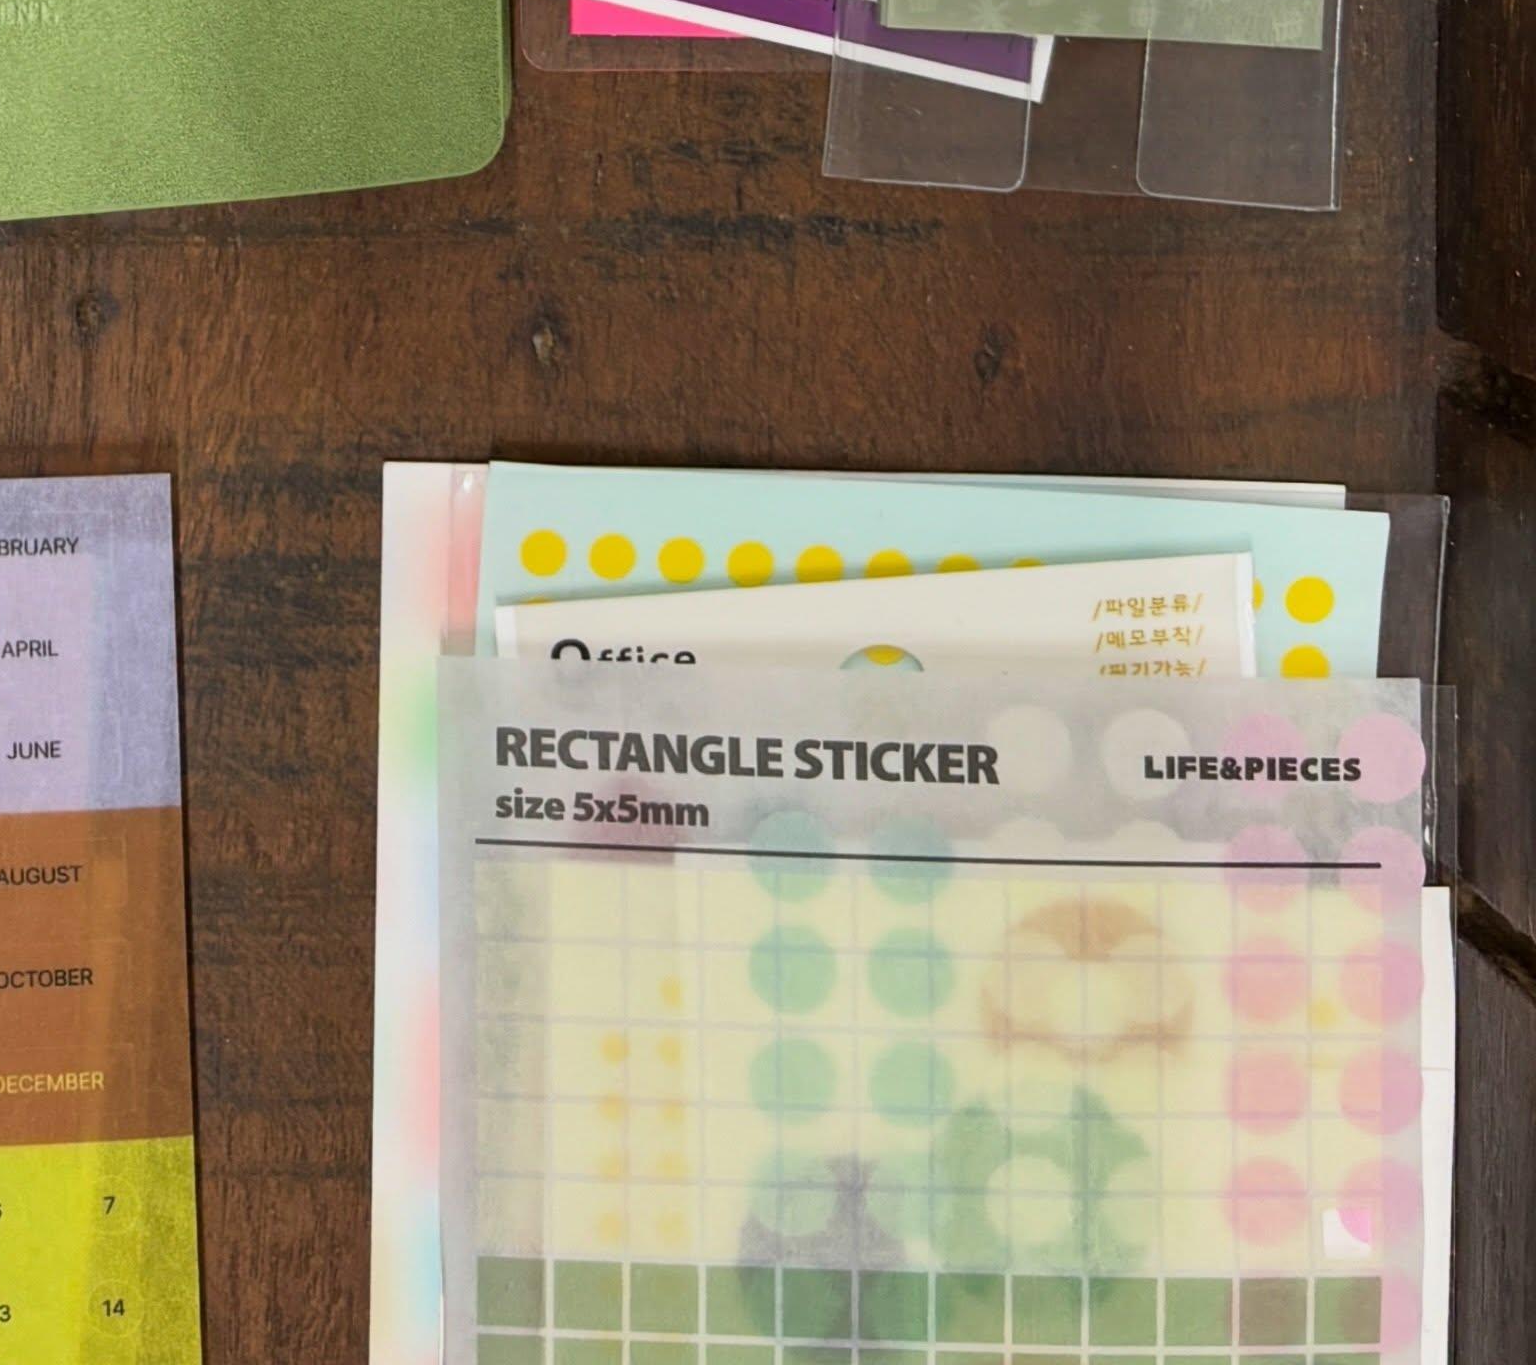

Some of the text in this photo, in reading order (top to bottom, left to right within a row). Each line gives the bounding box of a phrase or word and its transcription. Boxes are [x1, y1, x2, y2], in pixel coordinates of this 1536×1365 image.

[1, 640, 59, 658] APRIL
[7, 741, 61, 759] JUNE
[495, 726, 1000, 785] RECTANGLE STICKER
[1143, 755, 1362, 782] LIFE&PIECES
[495, 788, 710, 828] size 5x5mm
[103, 1196, 116, 1214] 7
[102, 1299, 125, 1317] 14
